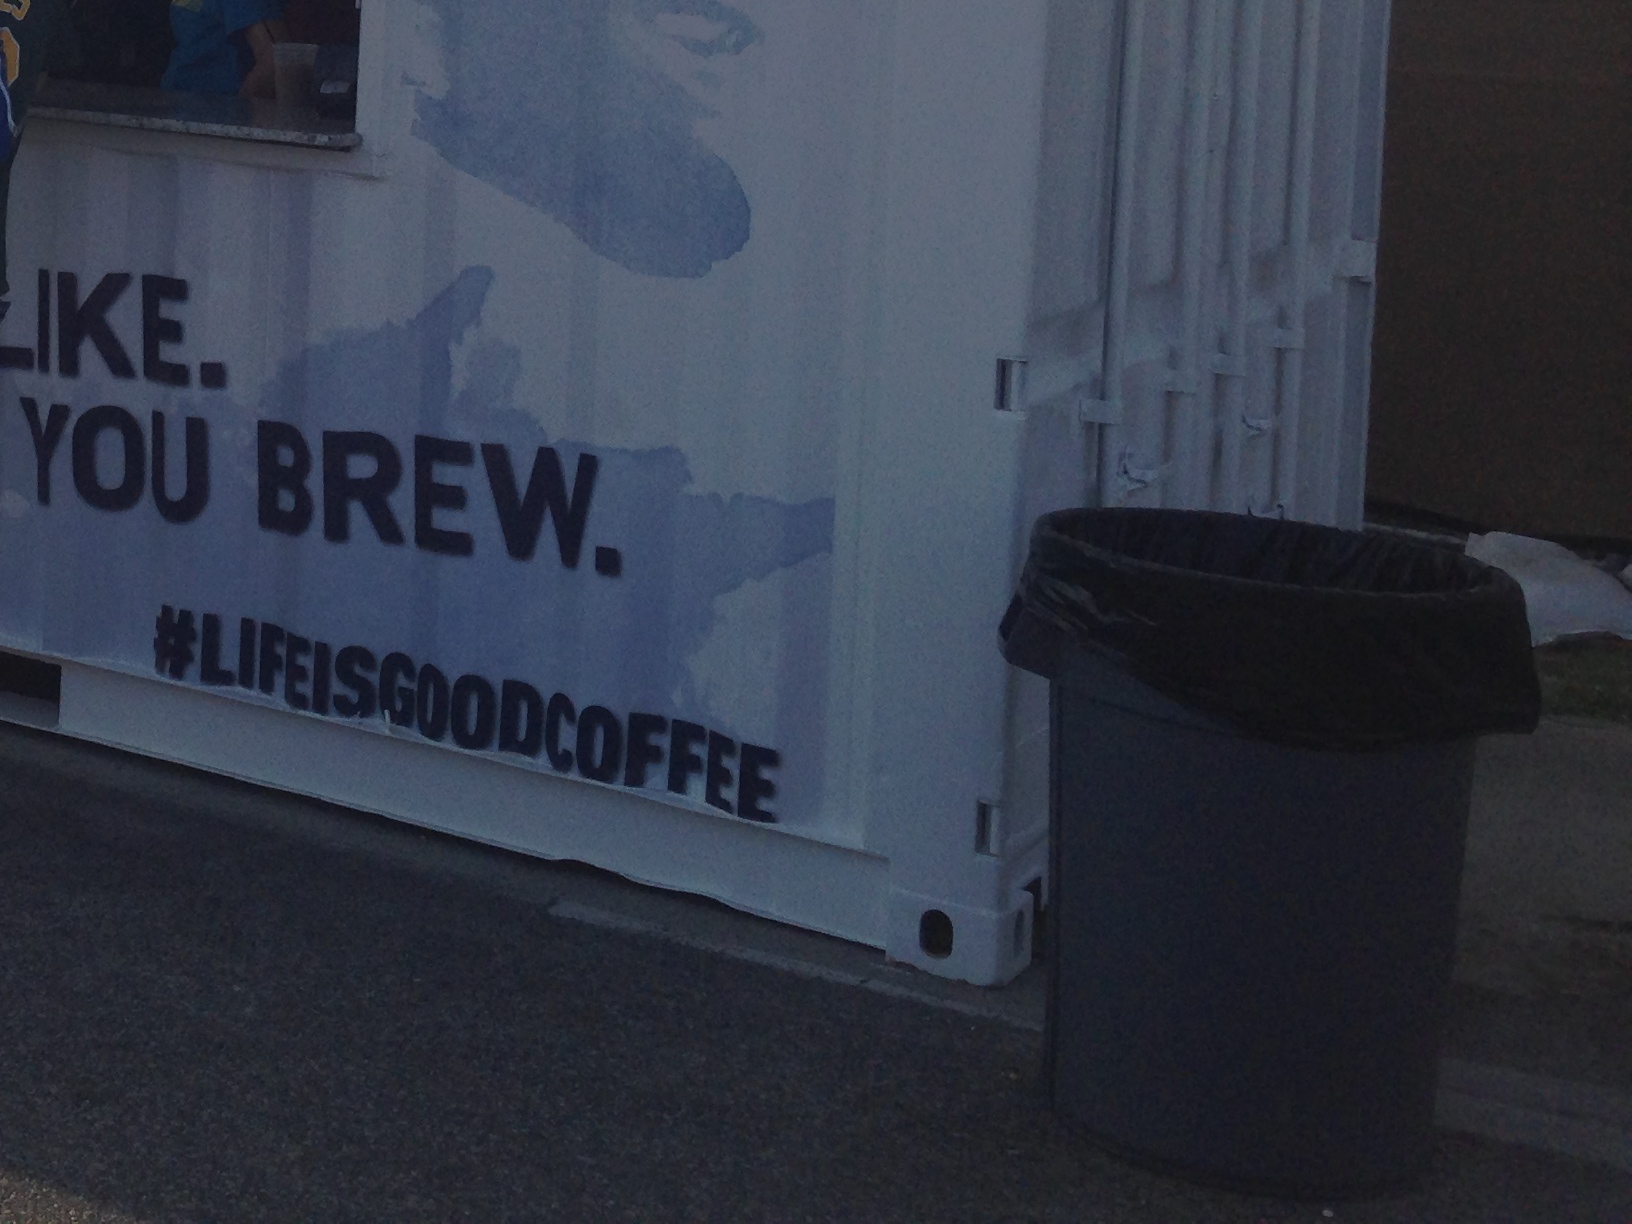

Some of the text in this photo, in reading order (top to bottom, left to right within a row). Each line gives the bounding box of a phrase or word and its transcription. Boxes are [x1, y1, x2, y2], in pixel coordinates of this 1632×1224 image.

[19, 396, 623, 576] YOU BREW.
[152, 604, 783, 824] #LIFEISGOODCOFFEE
